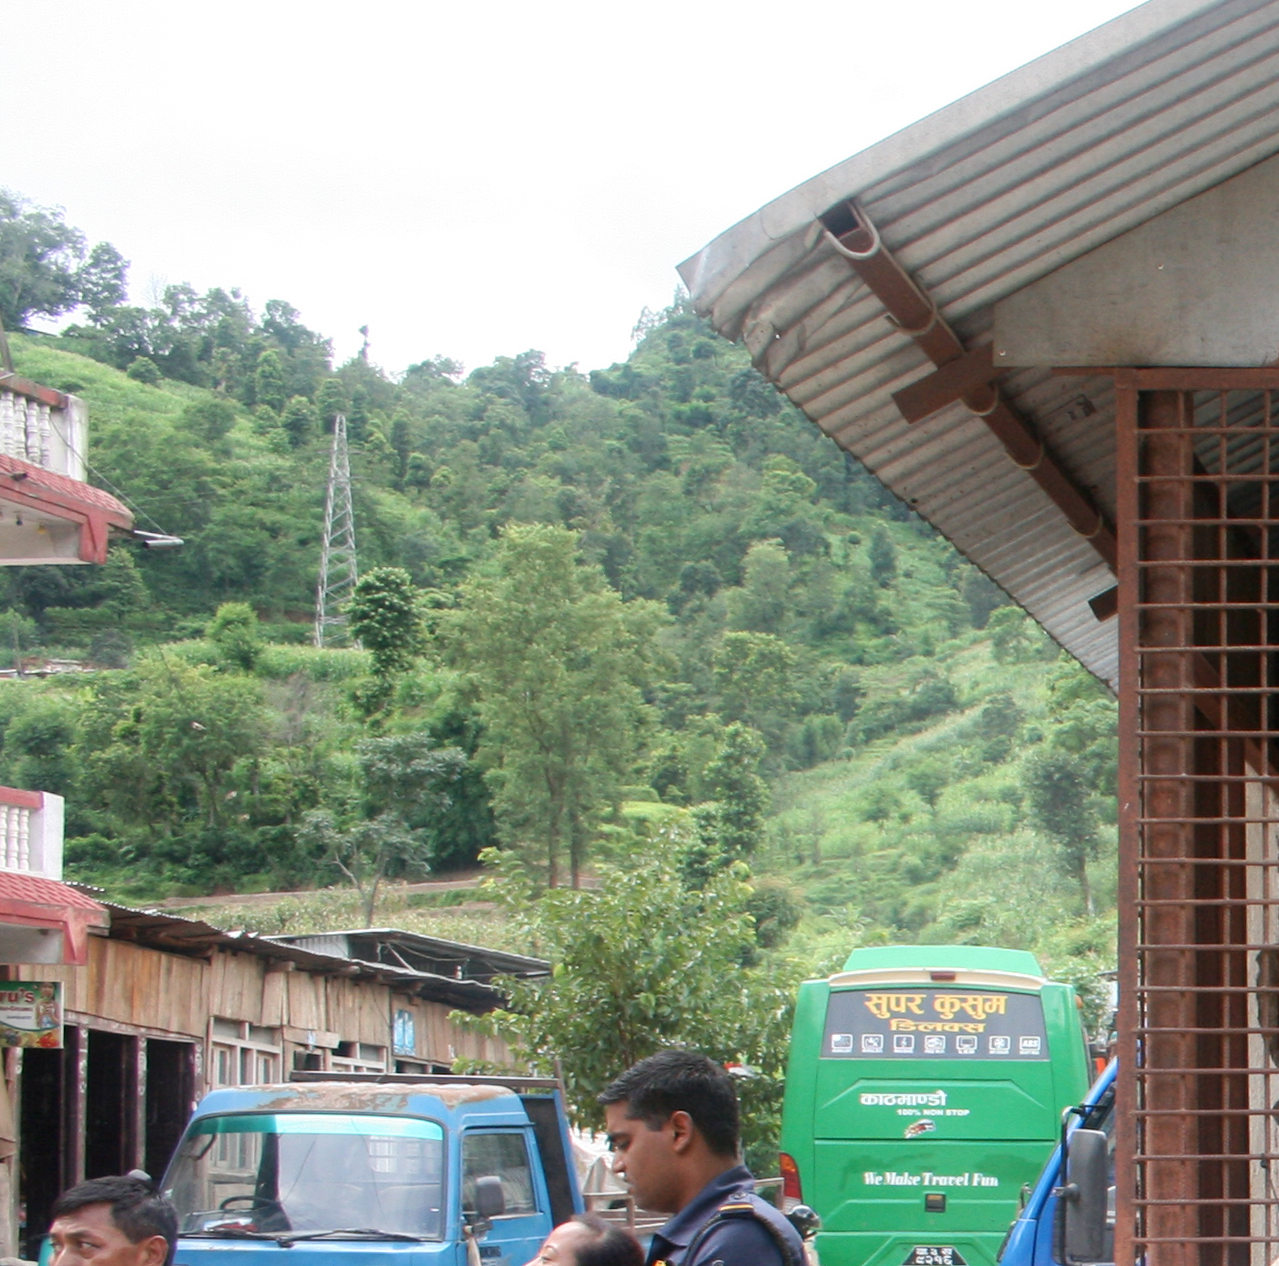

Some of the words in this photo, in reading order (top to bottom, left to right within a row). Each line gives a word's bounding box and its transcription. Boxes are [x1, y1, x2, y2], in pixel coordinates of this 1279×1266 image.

[864, 993, 927, 1018] सुपर
[933, 994, 1008, 1020] कुसुम
[863, 1172, 883, 1185] We
[884, 1172, 920, 1185] Make
[922, 1172, 968, 1186] Travel
[972, 1173, 998, 1187] Fun
